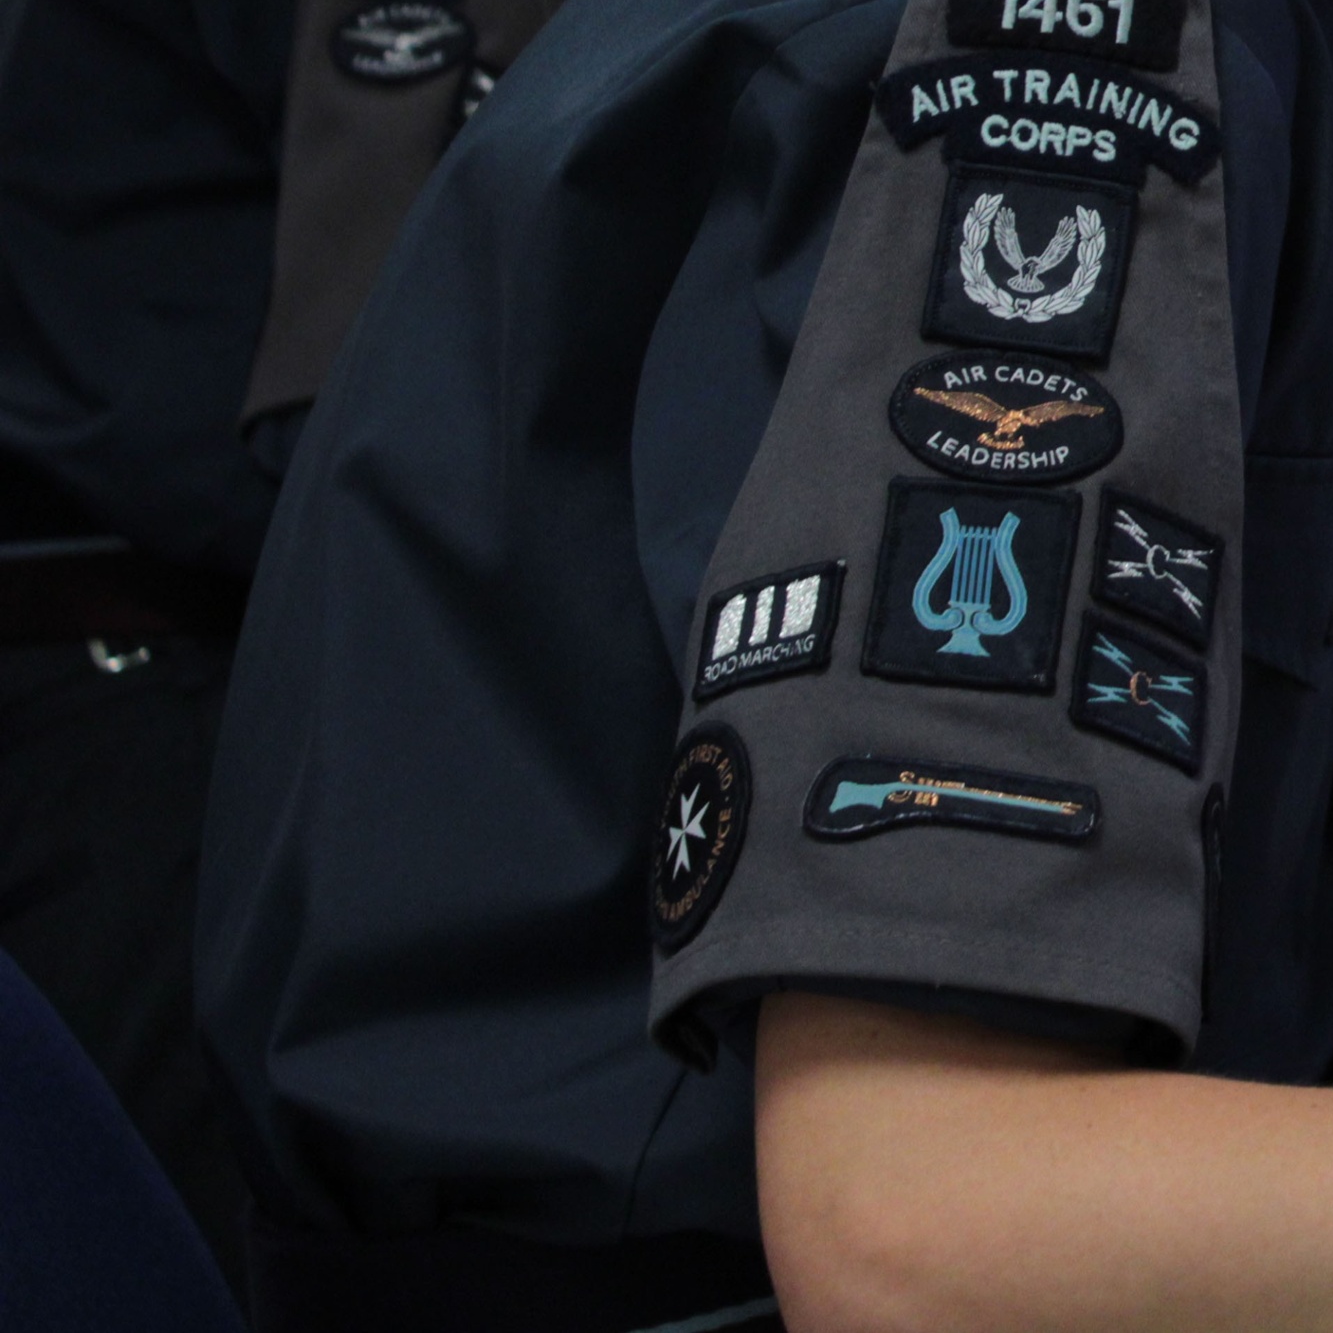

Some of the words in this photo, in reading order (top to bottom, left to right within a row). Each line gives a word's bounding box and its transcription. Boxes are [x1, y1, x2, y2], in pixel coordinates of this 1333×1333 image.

[910, 72, 980, 122] AIR
[992, 69, 1200, 152] TRAINING
[981, 114, 1117, 163] CORPS
[943, 365, 989, 389] AIR
[995, 364, 1089, 404] CADETS
[926, 428, 1071, 470] LEADERSHIP
[702, 655, 738, 684] ROAD
[738, 633, 816, 670] MARCHING
[688, 743, 723, 765] FIRST
[715, 757, 734, 791] AID
